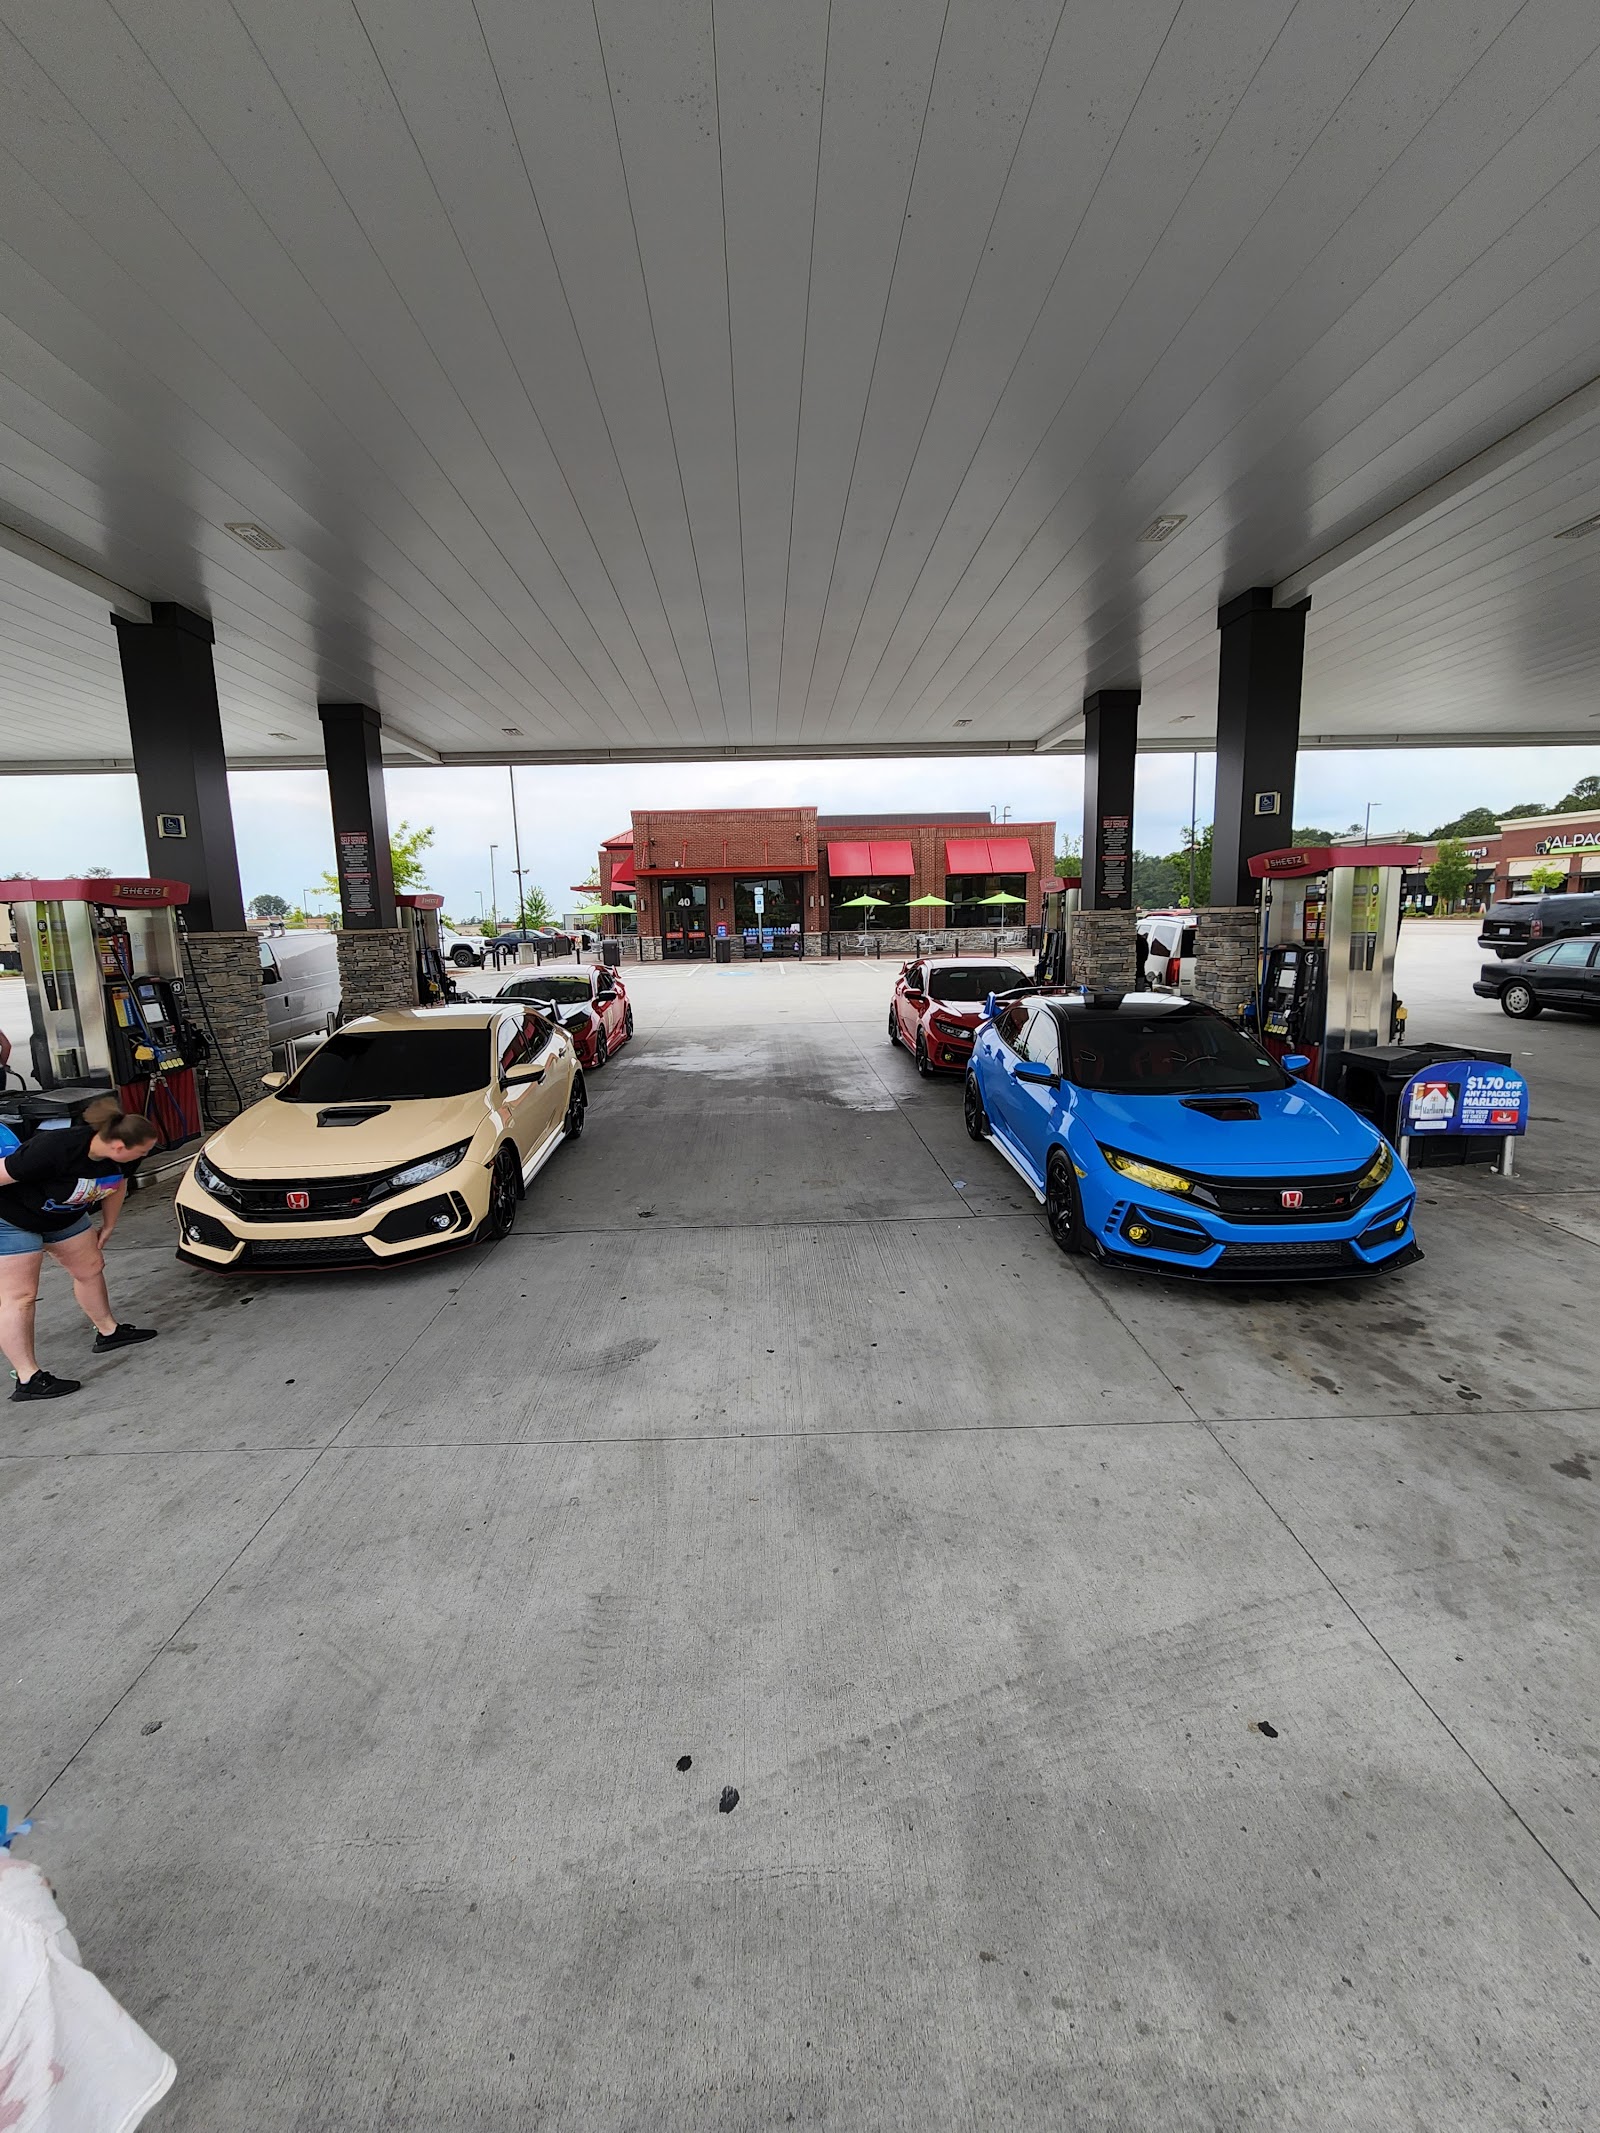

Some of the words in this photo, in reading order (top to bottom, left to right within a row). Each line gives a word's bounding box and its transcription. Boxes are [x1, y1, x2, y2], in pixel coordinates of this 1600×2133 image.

[1270, 855, 1303, 867] SHEETZ
[122, 886, 162, 896] SHEETZ
[678, 897, 691, 907] 40
[173, 983, 181, 992] 13
[1466, 1076, 1504, 1090] $1.70
[1505, 1081, 1522, 1090] OFF
[1463, 1098, 1520, 1107] MARLBORO
